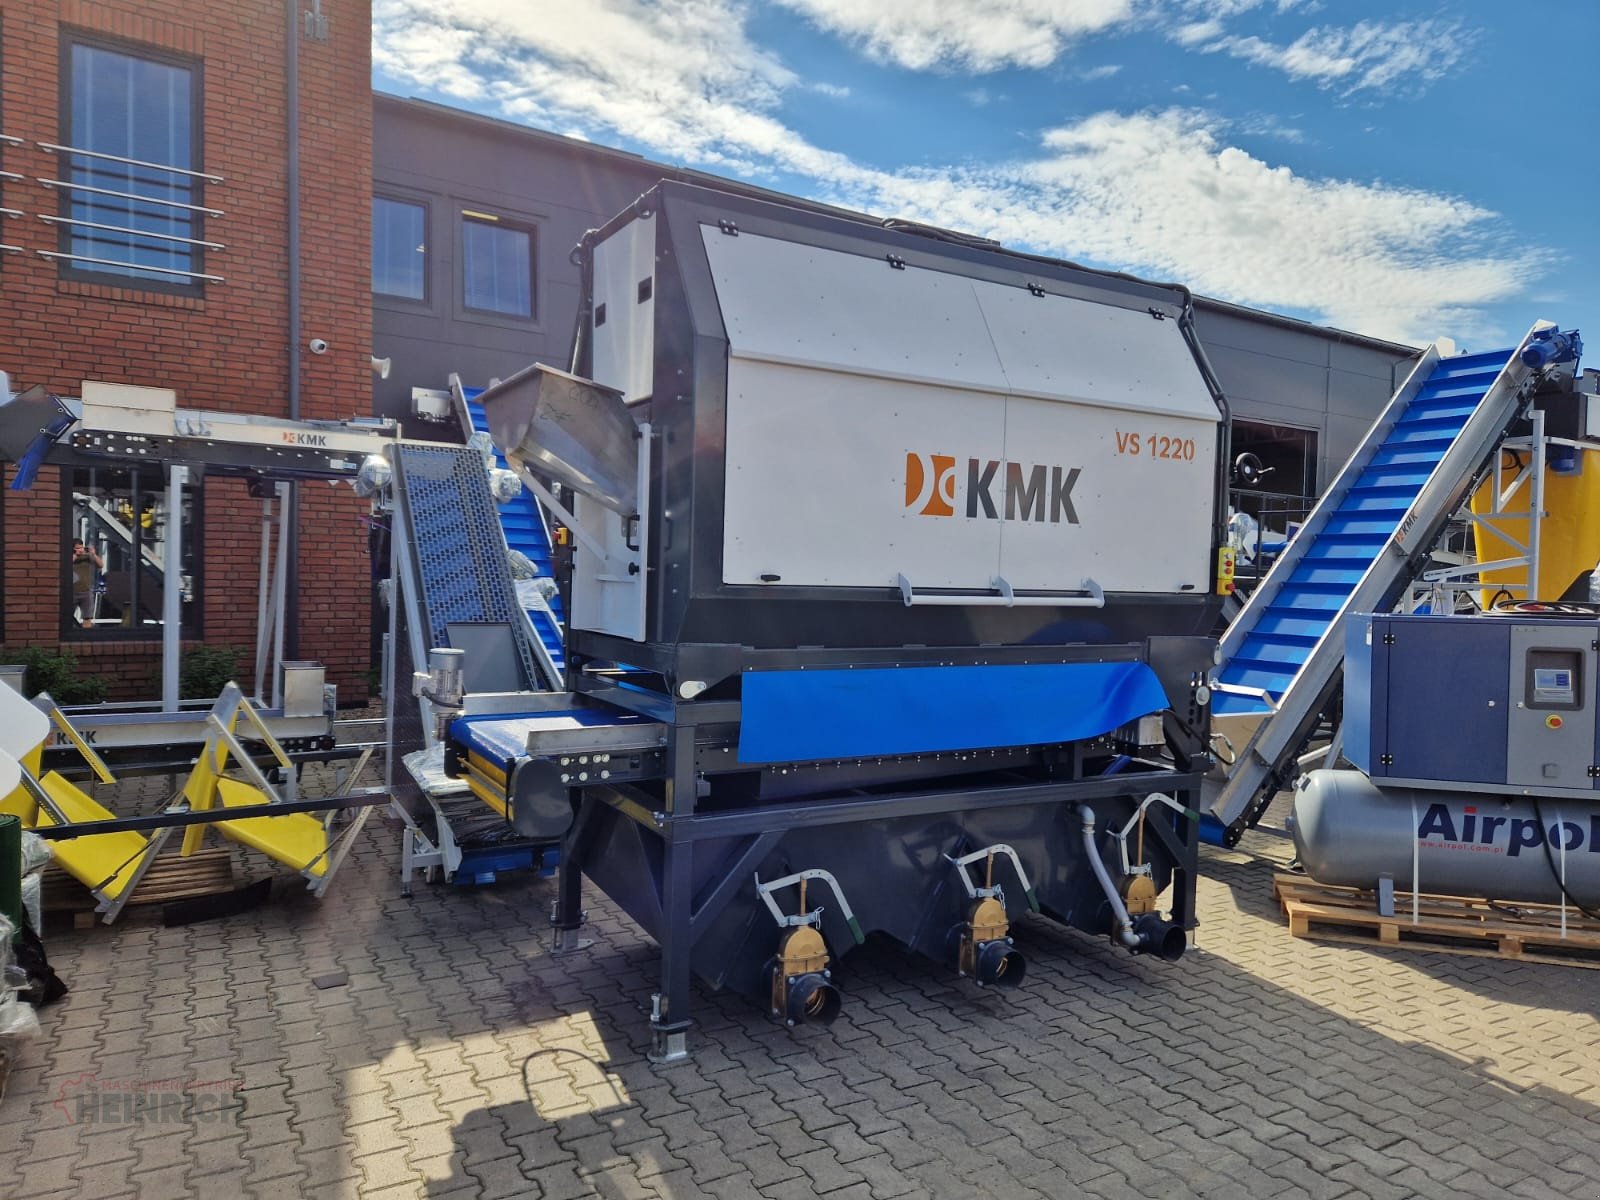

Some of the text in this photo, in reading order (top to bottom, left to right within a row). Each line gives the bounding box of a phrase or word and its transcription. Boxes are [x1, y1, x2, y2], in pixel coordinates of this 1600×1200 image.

[296, 433, 326, 447] KMK
[1115, 431, 1195, 461] VS 1220
[966, 458, 1082, 524] KMK
[1401, 510, 1418, 536] KMK
[56, 730, 97, 746] KK
